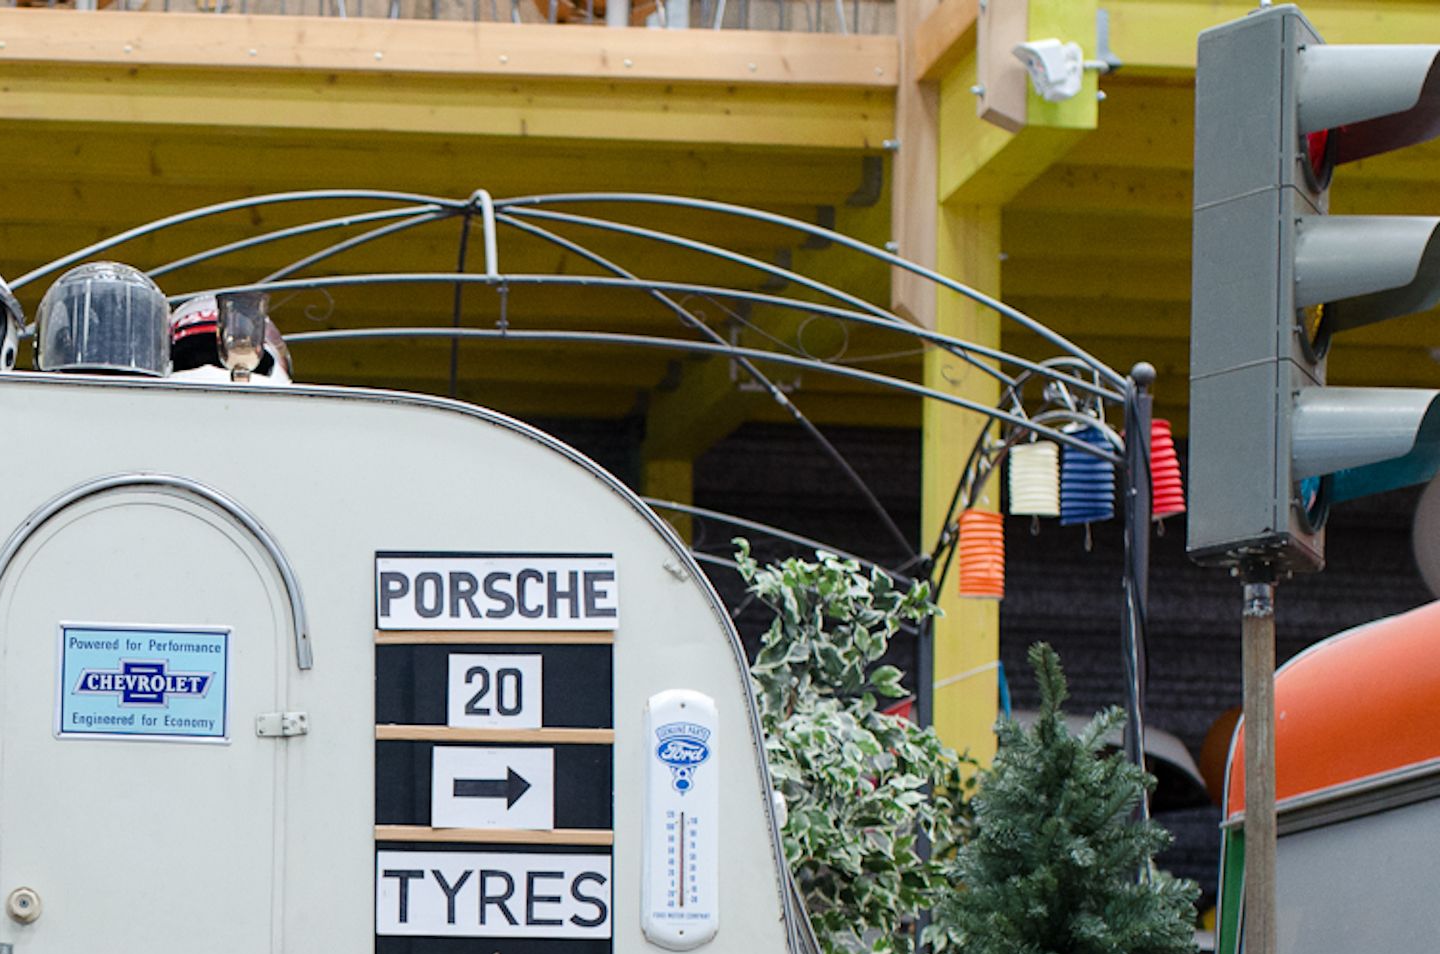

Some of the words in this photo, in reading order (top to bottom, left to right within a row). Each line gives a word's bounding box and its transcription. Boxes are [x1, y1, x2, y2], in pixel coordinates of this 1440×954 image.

[379, 567, 617, 619] PORSCHE
[68, 636, 120, 650] Powered
[125, 638, 142, 651] for
[148, 639, 222, 654] Performance
[86, 673, 203, 693] CHEVROLET
[464, 666, 523, 717] 20
[71, 711, 136, 727] Engineered
[141, 713, 158, 727] for
[163, 714, 216, 730] Economy
[660, 740, 706, 761] Ford
[382, 869, 608, 928] TYRES
